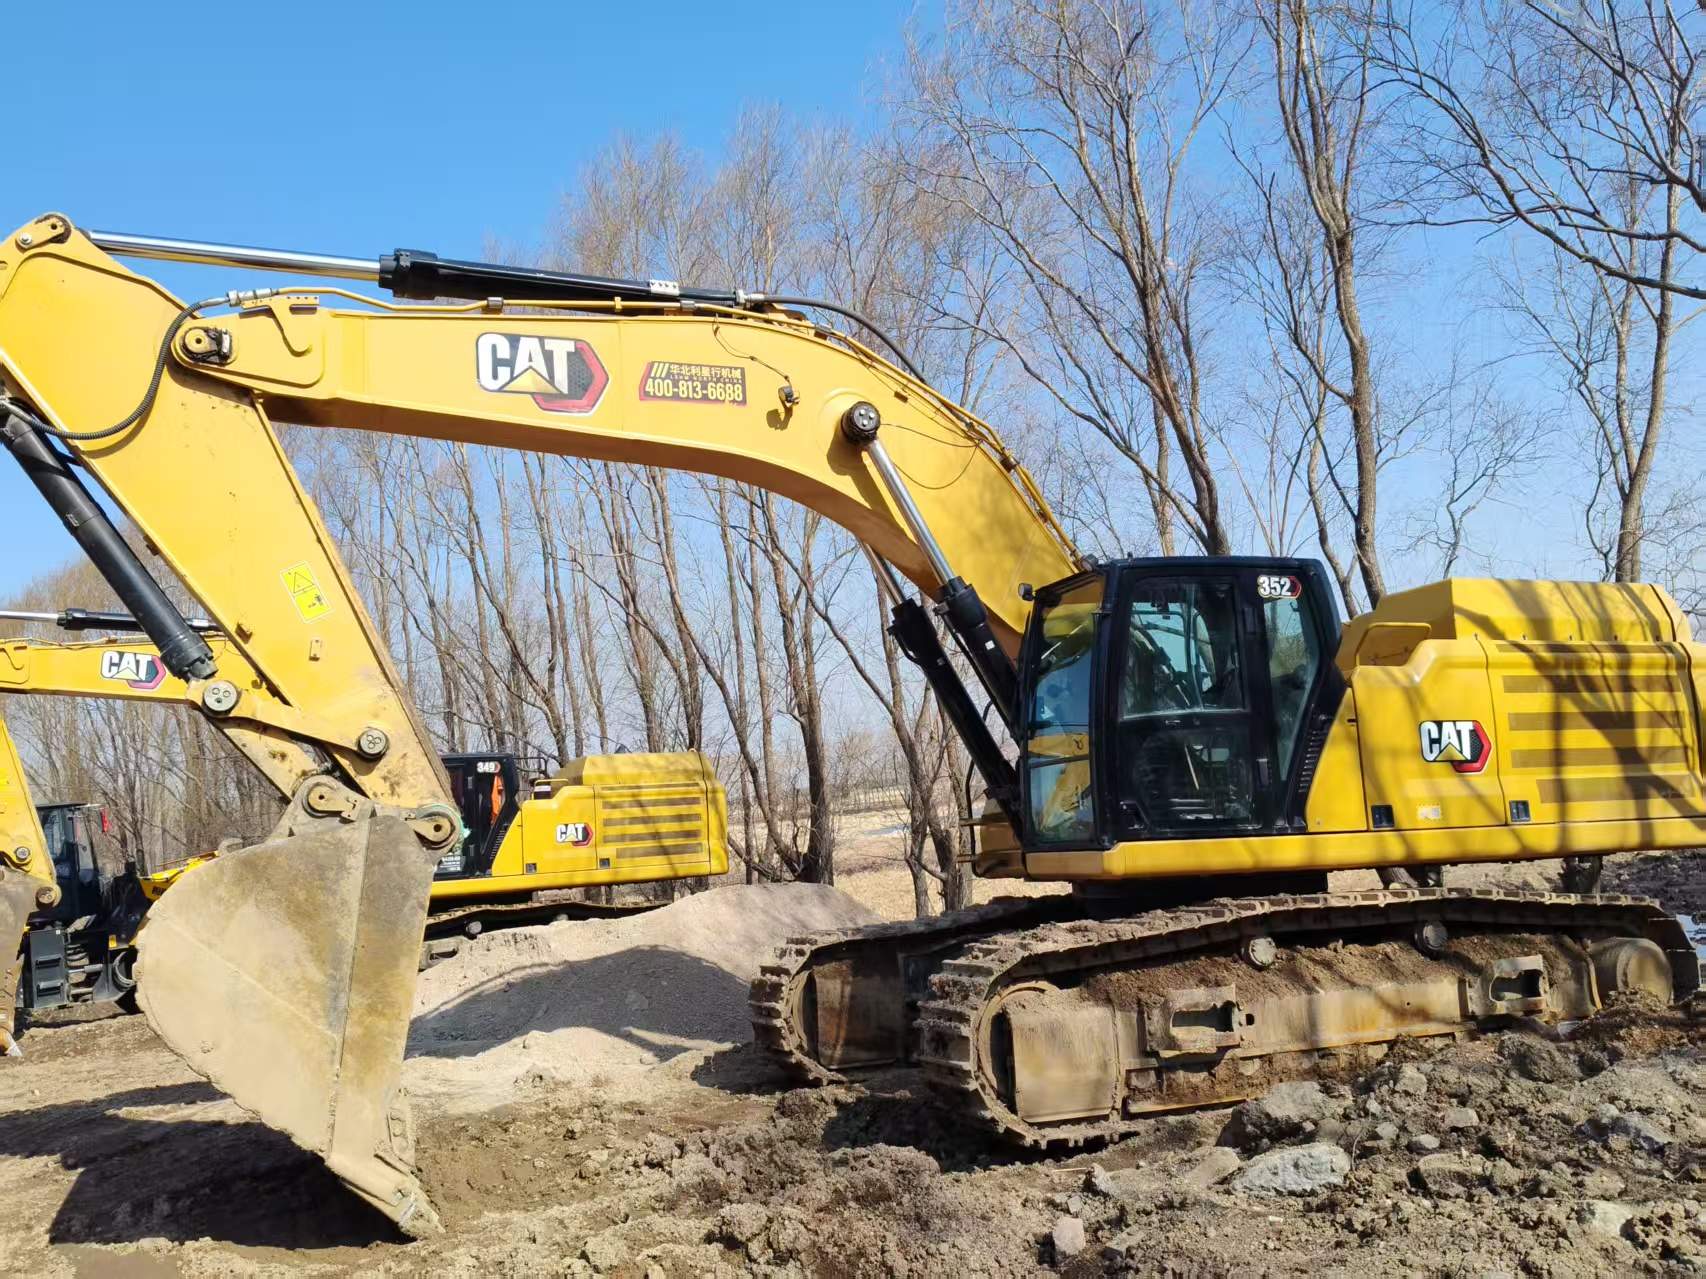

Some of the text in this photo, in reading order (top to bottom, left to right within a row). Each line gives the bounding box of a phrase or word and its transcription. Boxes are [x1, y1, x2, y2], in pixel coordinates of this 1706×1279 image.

[477, 332, 576, 394] CAT
[645, 378, 743, 401] 400-813-6688
[1259, 576, 1292, 596] 352
[101, 651, 152, 681] CAT
[1420, 721, 1474, 761] CAT
[477, 761, 495, 773] 349
[556, 823, 585, 842] CAT
